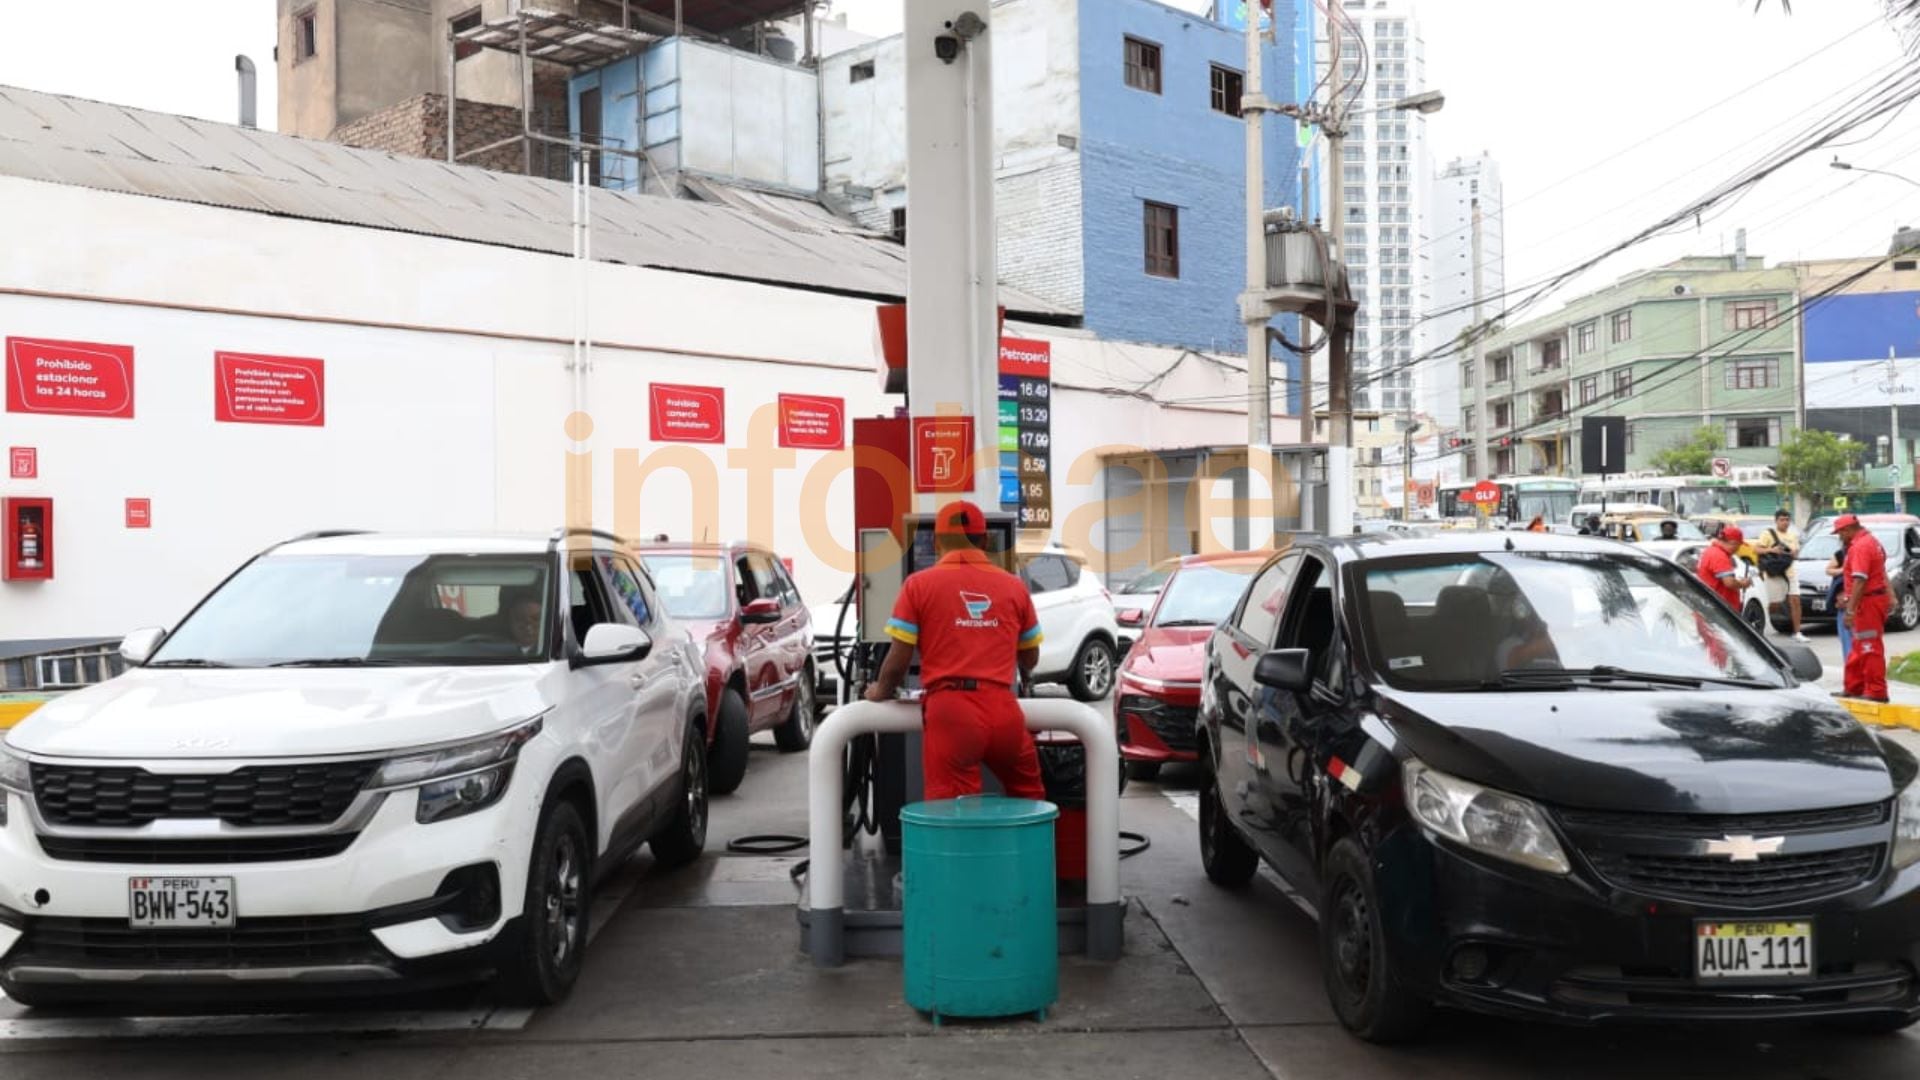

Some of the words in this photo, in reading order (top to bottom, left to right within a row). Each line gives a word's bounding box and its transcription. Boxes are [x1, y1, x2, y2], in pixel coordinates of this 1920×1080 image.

[1000, 347, 1048, 364] Petroperú
[36, 357, 92, 371] Prohibido
[36, 373, 98, 384] estacionar
[234, 367, 270, 378] Prohibido
[36, 384, 54, 395] las
[56, 386, 71, 396] 24
[73, 388, 106, 398] horas
[1020, 382, 1048, 398] 16.49
[666, 398, 700, 408] Prohibido
[666, 410, 698, 418] comercio
[1020, 408, 1048, 423] 13.29
[666, 420, 710, 429] ambulatorio
[924, 430, 961, 439] Extintor
[1021, 432, 1049, 448] 17.99
[1024, 458, 1046, 472] 6.59
[1021, 483, 1043, 498] 1.95
[1476, 490, 1496, 500] GLP
[955, 616, 998, 628] Petroperú
[162, 879, 200, 890] PERU
[134, 890, 229, 920] BWW-543
[1734, 922, 1776, 936] PERU
[1702, 936, 1808, 971] AUA-111
